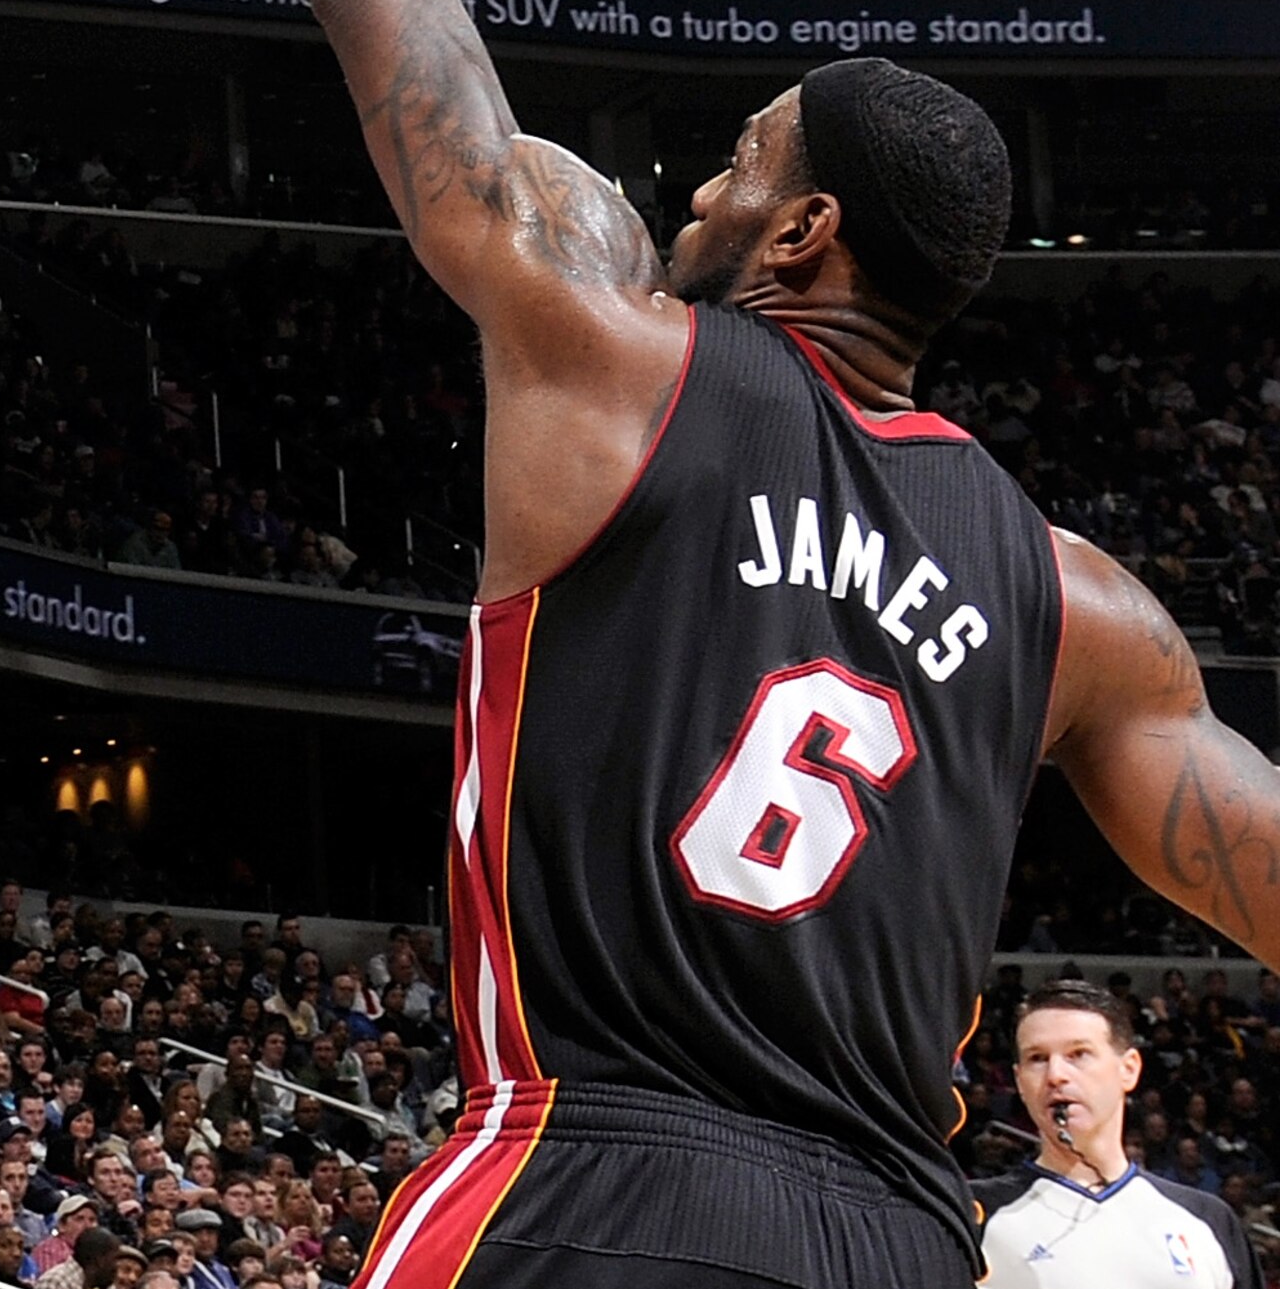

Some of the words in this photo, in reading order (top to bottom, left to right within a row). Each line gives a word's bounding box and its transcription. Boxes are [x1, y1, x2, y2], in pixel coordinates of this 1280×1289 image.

[569, 0, 640, 38] with
[648, 15, 674, 39] a
[682, 9, 778, 44] turbo
[790, 11, 918, 52] engine
[928, 9, 1105, 44] standard.
[4, 580, 147, 644] standard.
[737, 494, 990, 683] JAMES
[669, 656, 919, 924] 6
